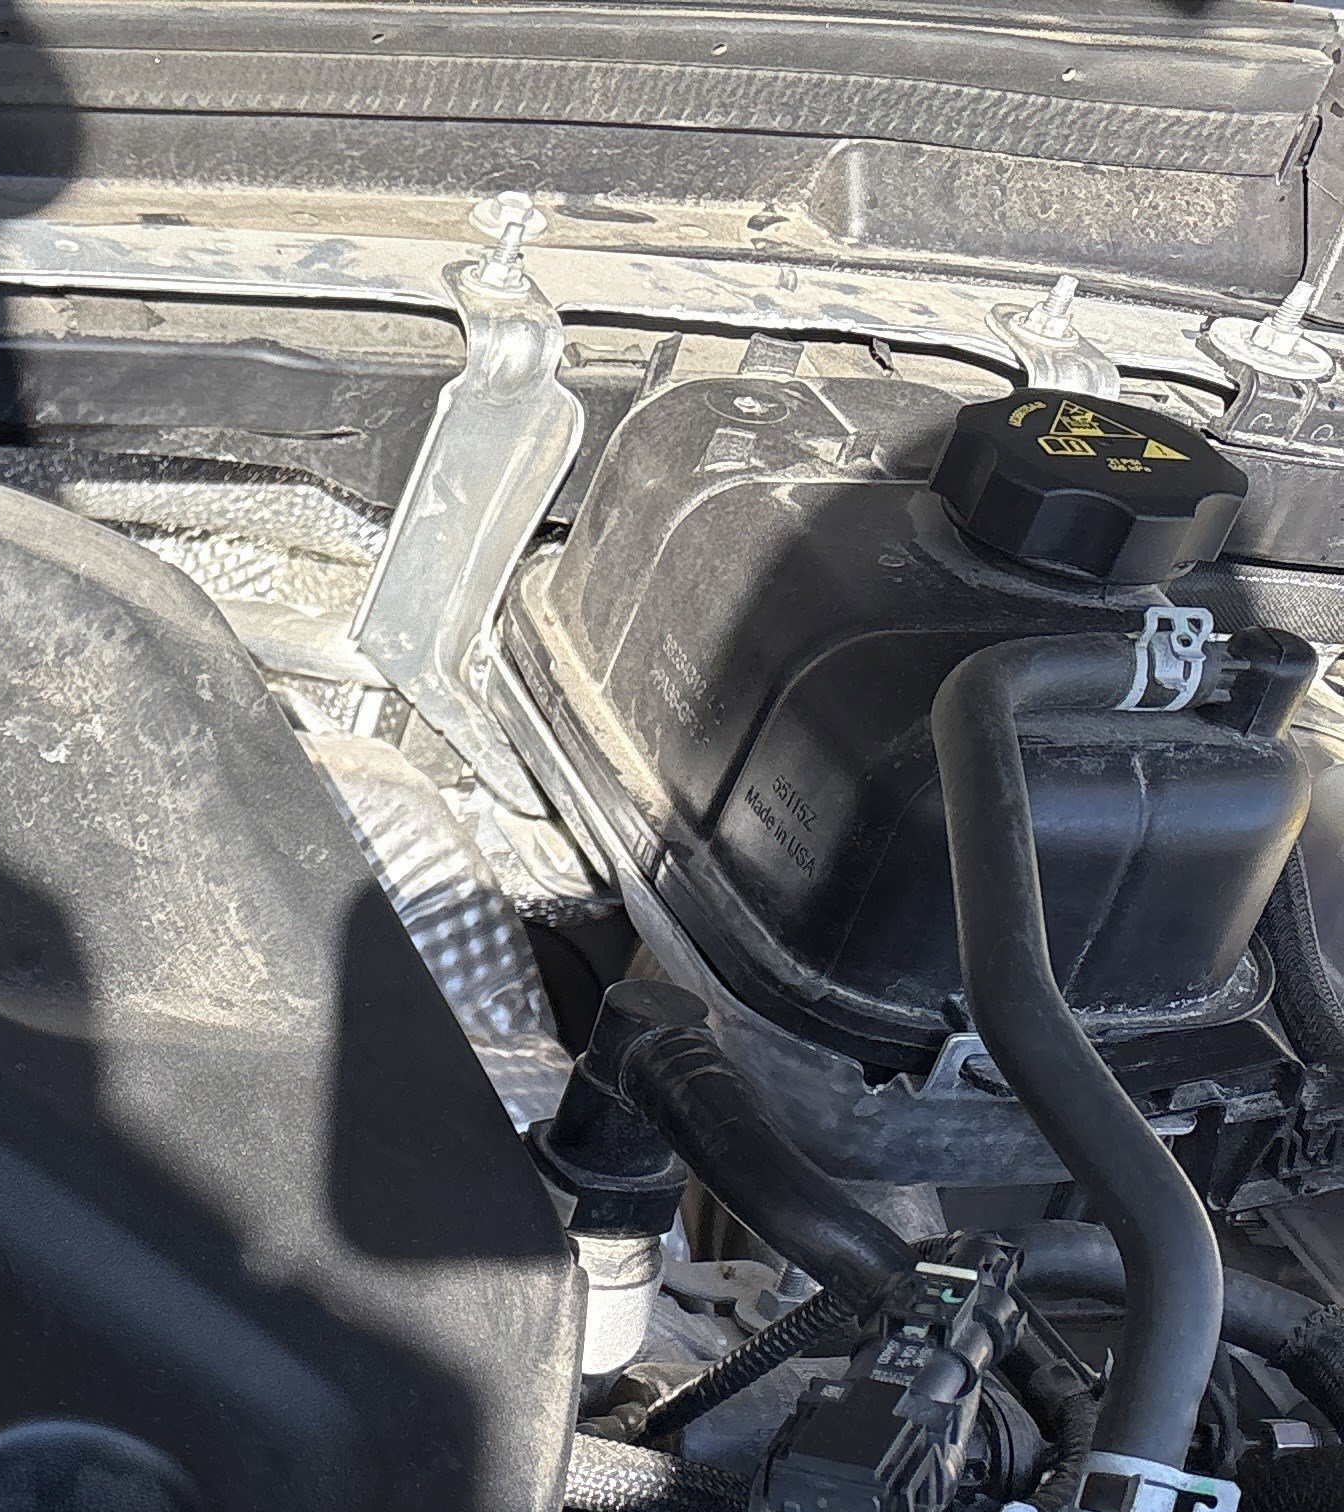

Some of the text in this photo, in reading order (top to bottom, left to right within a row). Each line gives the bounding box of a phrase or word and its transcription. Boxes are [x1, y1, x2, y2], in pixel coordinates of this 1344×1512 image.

[744, 784, 818, 878] Made in USA
